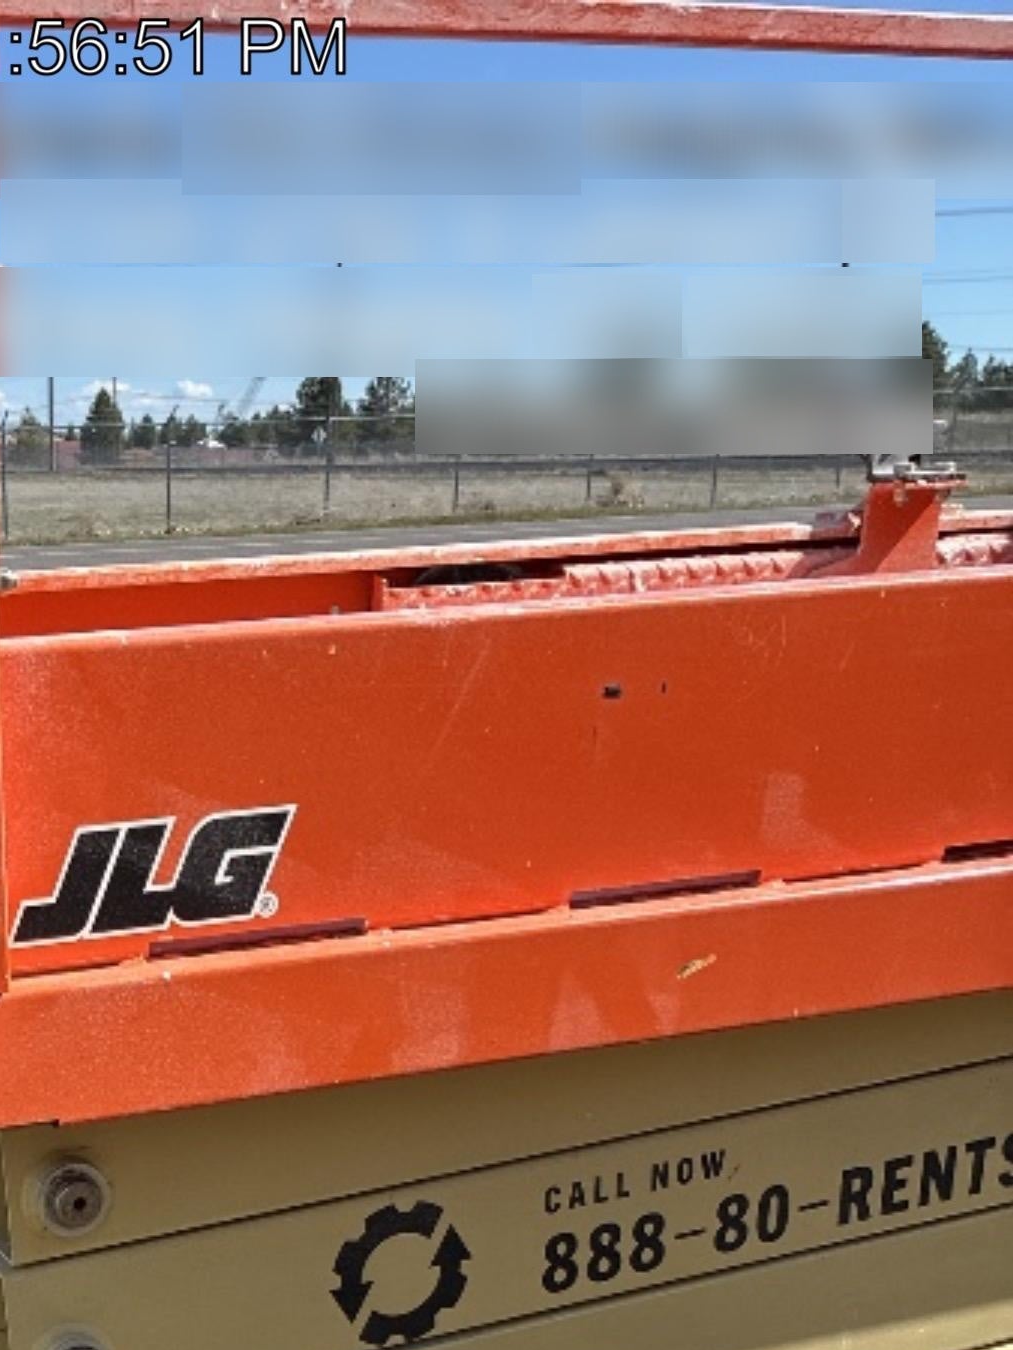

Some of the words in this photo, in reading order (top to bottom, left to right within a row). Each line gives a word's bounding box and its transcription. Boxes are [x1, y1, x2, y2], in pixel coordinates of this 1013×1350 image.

[8, 803, 299, 949] JLG
[544, 1172, 631, 1214] CALL
[650, 1149, 726, 1192] NOW
